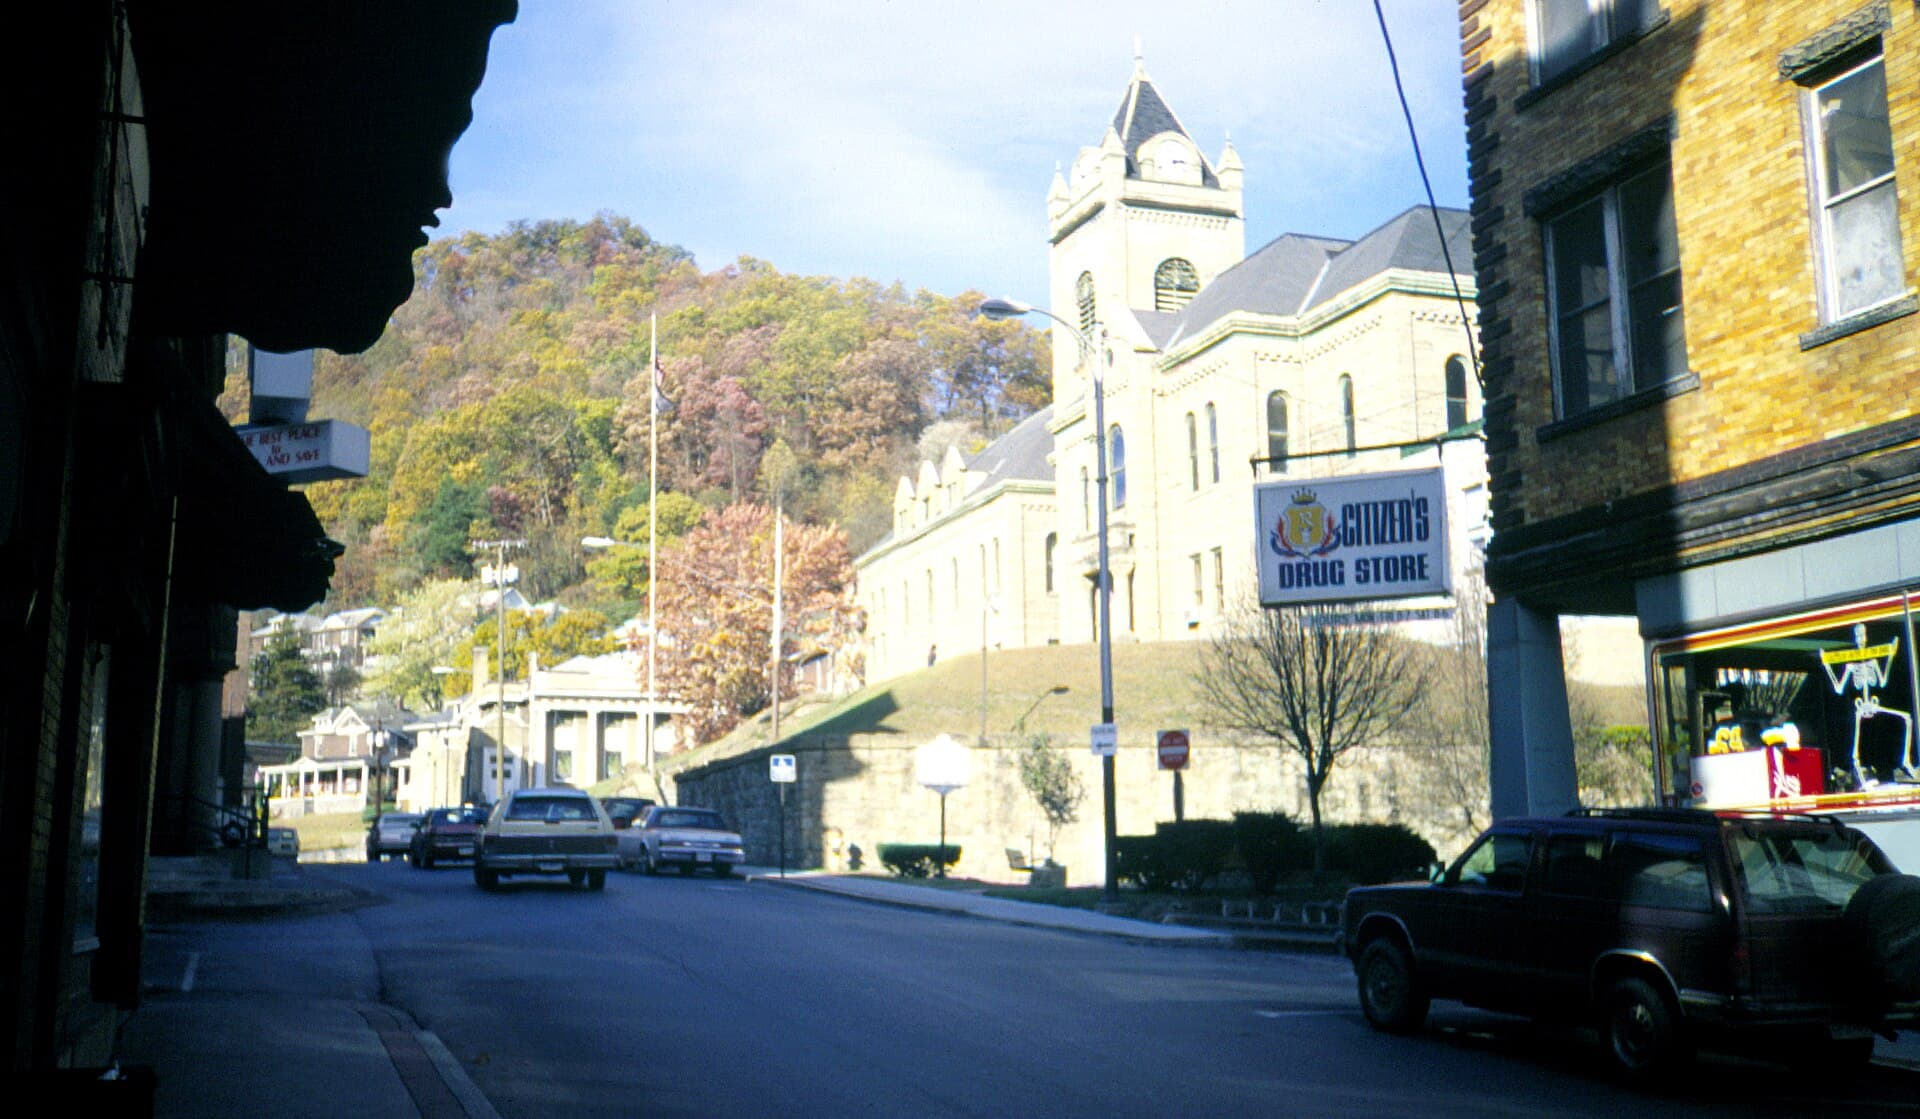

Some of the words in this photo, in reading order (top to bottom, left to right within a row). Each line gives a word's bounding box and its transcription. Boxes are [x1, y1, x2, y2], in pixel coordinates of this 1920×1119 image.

[259, 432, 281, 445] BEST
[289, 425, 320, 441] PLACE
[266, 453, 290, 466] AND
[297, 448, 320, 462] SAVE
[1341, 488, 1430, 548] CITIZEN'S
[1278, 560, 1345, 590] DRUG
[1355, 553, 1430, 584] STORE
